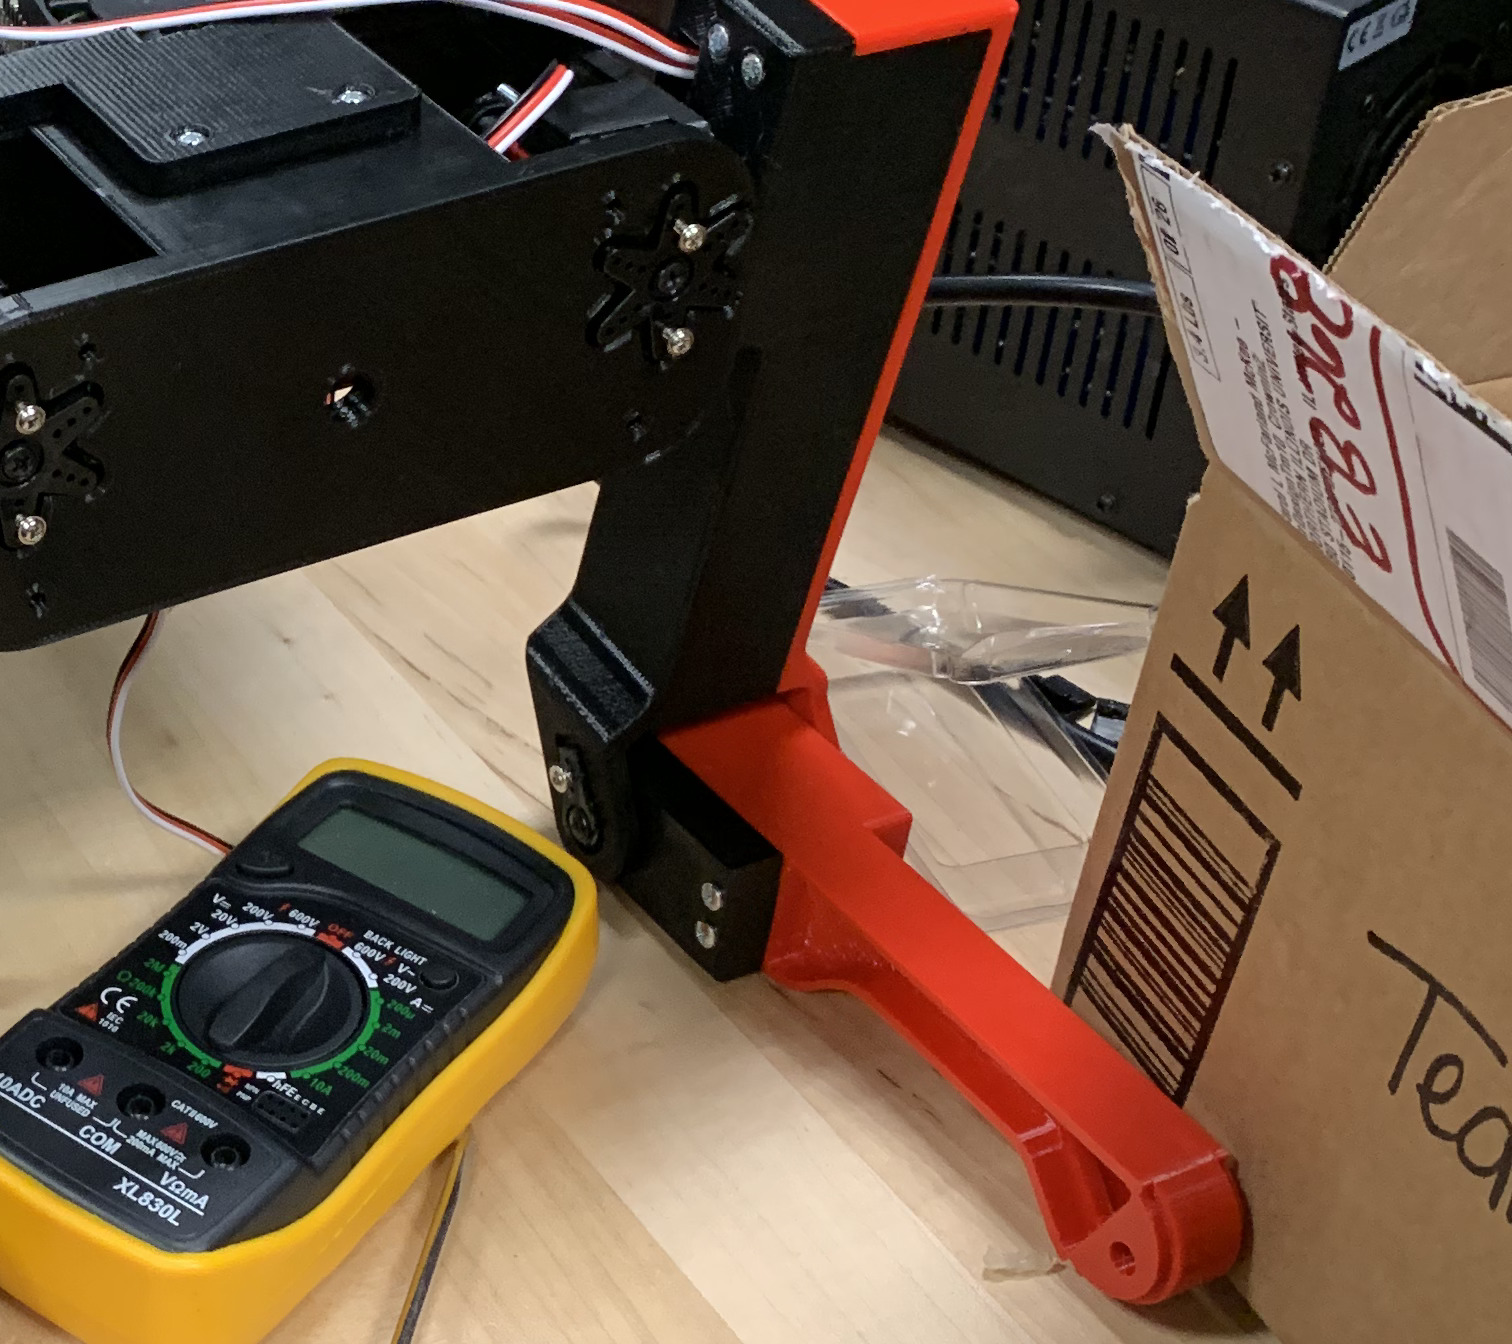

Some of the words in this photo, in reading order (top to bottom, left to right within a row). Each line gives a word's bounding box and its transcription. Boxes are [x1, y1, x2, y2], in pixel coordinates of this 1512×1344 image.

[1252, 300, 1285, 397] UNIVERSIT
[1276, 399, 1302, 469] ILLINOIS
[211, 909, 237, 926] 20V
[242, 901, 274, 921] 200V
[288, 909, 321, 928] 600V
[189, 922, 210, 935] 2V
[327, 923, 355, 939] OFF
[158, 929, 187, 950] 200m
[363, 929, 392, 950] BACK
[394, 945, 428, 966] LIGHT
[353, 942, 387, 962] 600V
[143, 957, 166, 973] 2M
[383, 973, 417, 994] 200V
[100, 986, 139, 1014] CE
[106, 1011, 125, 1025] IEC
[381, 1024, 401, 1039] 2m
[363, 1046, 390, 1065] 20m
[187, 1060, 212, 1078] 200
[336, 1064, 371, 1088] 200m
[309, 1077, 333, 1096] 10A
[50, 1089, 91, 1118] UNFUSED
[76, 1093, 98, 1110] MAX
[78, 1125, 123, 1155] COM
[126, 1135, 156, 1158] 200mA
[156, 1150, 180, 1170] MAX
[160, 1171, 210, 1210] VΩmA
[112, 1176, 183, 1227] XL830L
